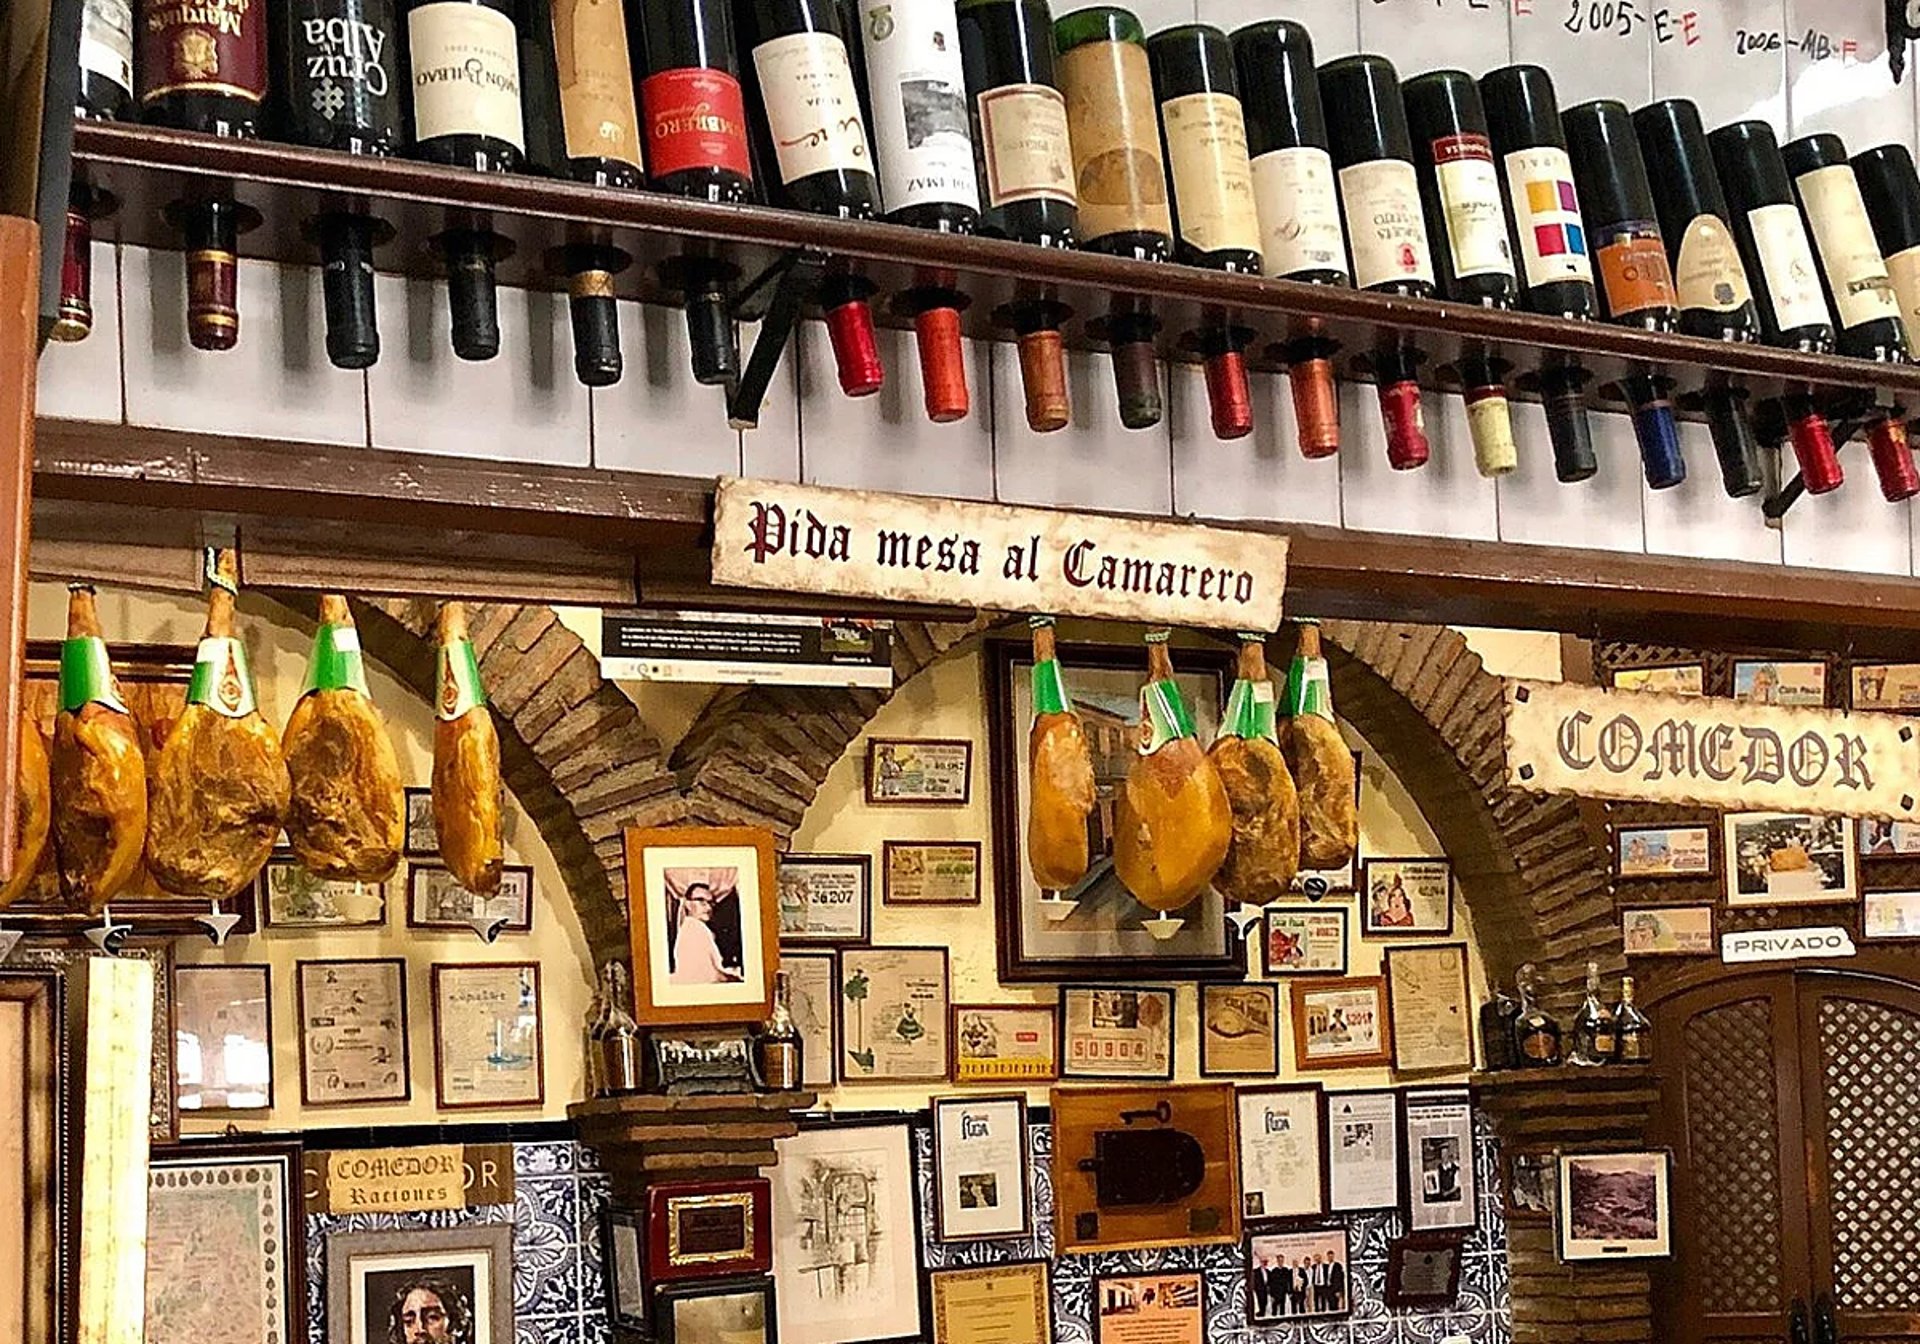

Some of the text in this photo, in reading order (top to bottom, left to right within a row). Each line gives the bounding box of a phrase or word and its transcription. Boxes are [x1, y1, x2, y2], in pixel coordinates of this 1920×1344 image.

[302, 17, 386, 62] Alba
[306, 55, 388, 96] Cruz
[416, 58, 486, 89] BILBAO
[743, 501, 1255, 606] Pida mesa al Camarero
[1556, 709, 1875, 792] COMEDOR
[811, 890, 854, 904] 36207
[1733, 934, 1842, 954] PRIVADO
[336, 1154, 456, 1181] COMEDOR
[349, 1186, 448, 1206] Raciones
